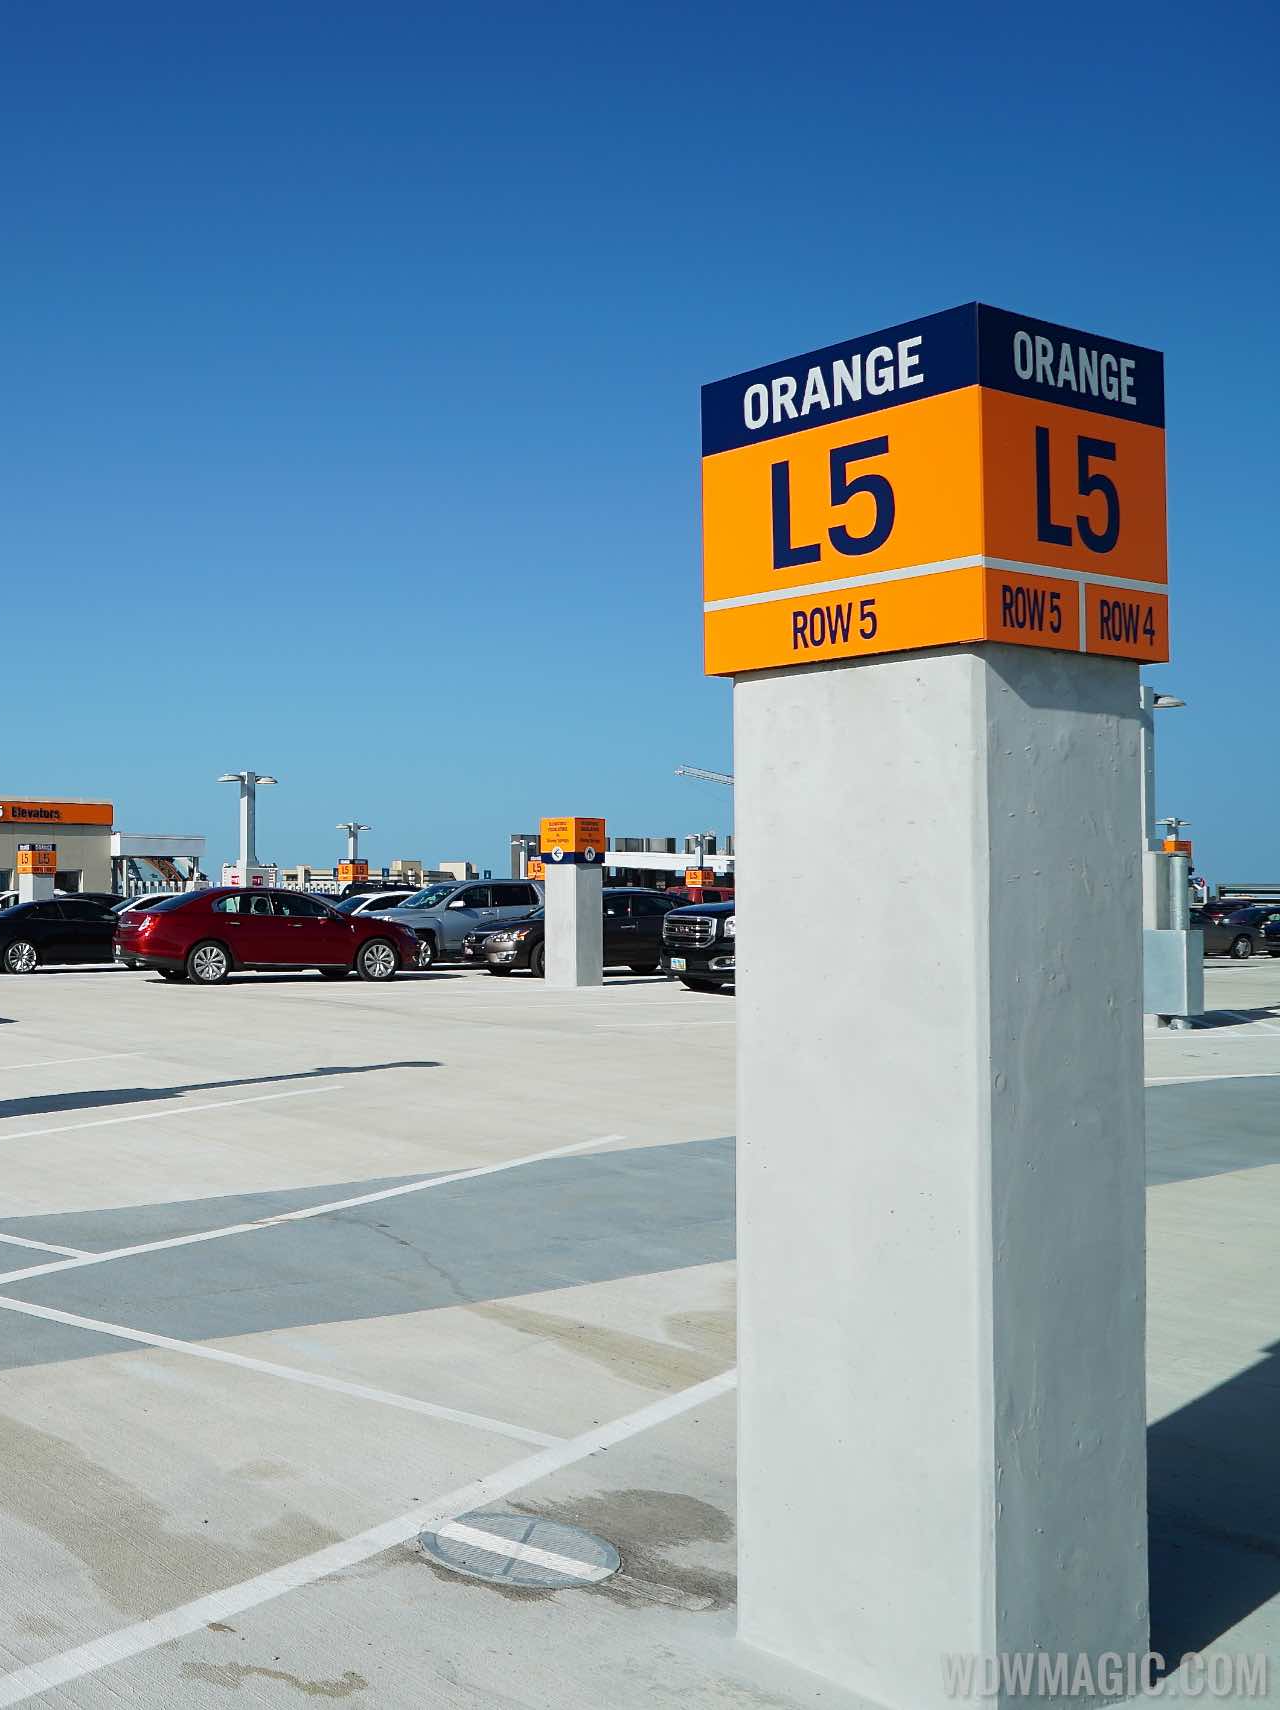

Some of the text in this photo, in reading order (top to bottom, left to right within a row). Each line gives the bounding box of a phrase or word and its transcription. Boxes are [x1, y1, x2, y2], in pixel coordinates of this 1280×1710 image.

[743, 335, 924, 430] ORANGE
[1013, 331, 1137, 405] ORANGE
[771, 435, 896, 570] L5
[1035, 425, 1120, 554] L5
[792, 598, 878, 649] ROW 5
[1002, 585, 1062, 634] ROW 5
[1099, 599, 1156, 646] ROW 4
[11, 806, 61, 819] Elevators
[532, 862, 541, 872] L5
